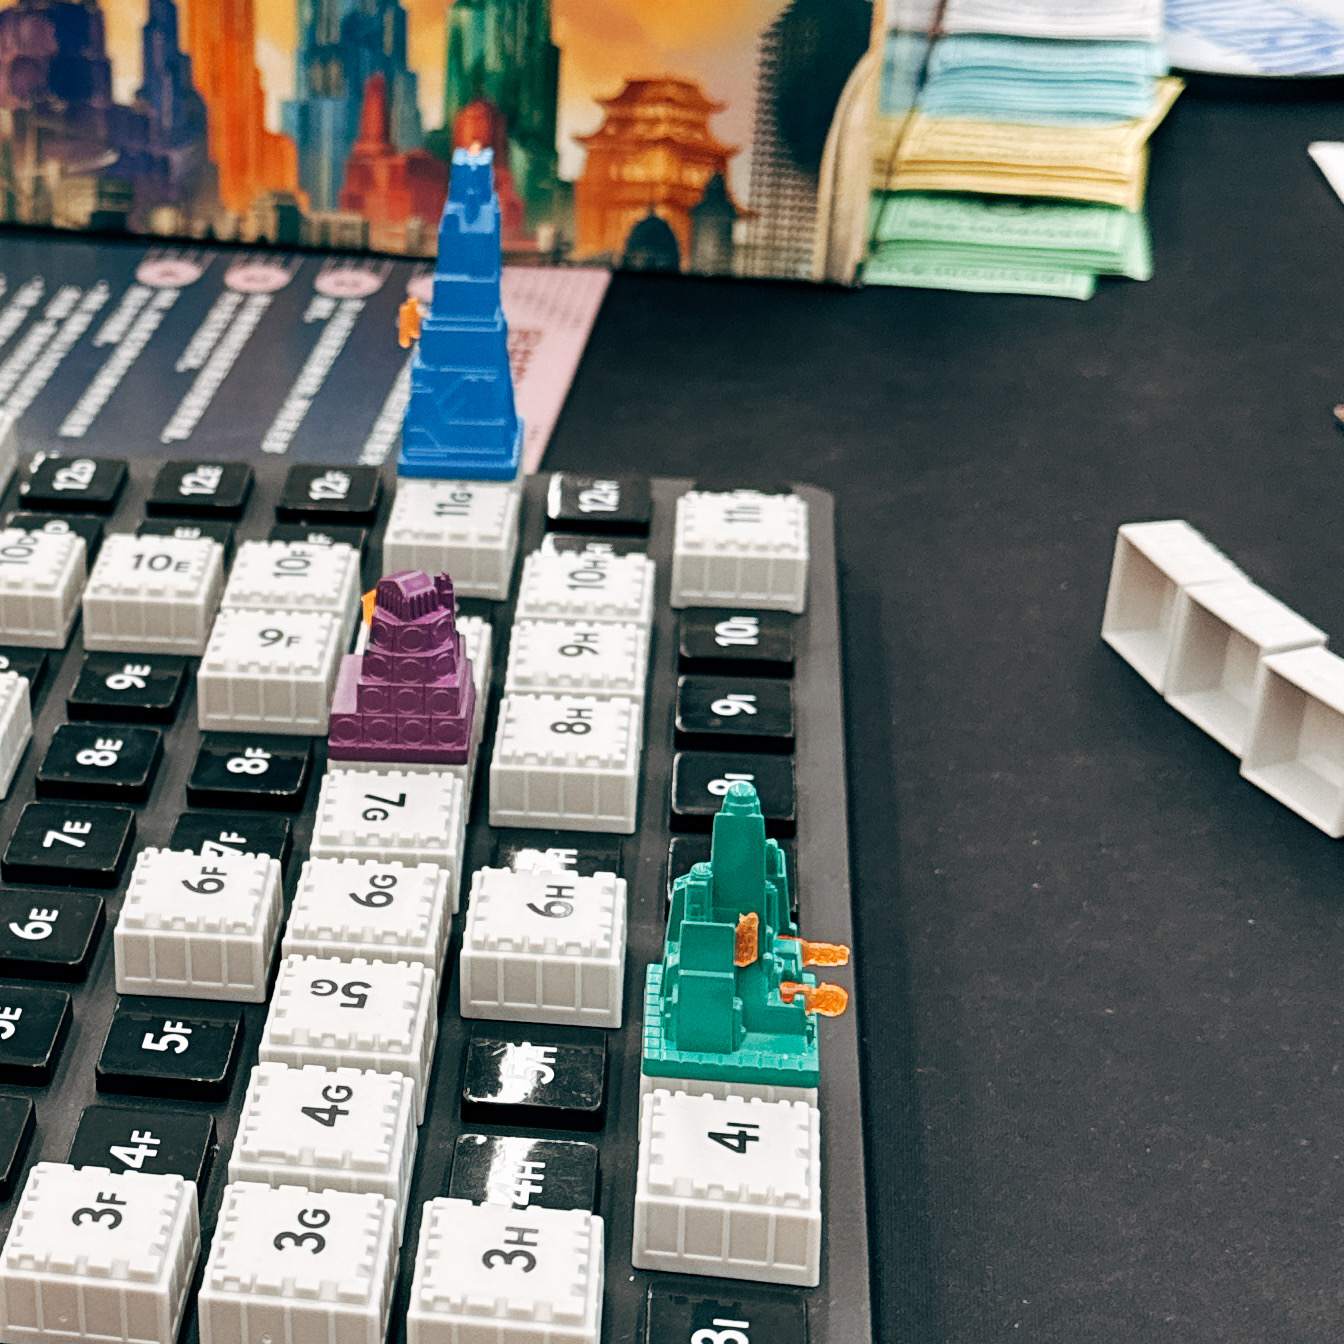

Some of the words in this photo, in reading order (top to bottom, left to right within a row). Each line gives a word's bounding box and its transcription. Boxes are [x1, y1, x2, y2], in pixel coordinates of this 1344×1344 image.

[52, 459, 96, 490] 12D
[180, 465, 223, 496] 12E
[309, 470, 351, 500] 12F
[434, 491, 472, 517] 11G
[579, 480, 620, 512] 12H
[132, 553, 191, 573] 10E
[273, 550, 312, 576] 10F
[568, 557, 606, 591] 10H
[259, 628, 301, 648] 9F
[558, 632, 599, 657] 9H
[715, 617, 759, 646] 10I
[106, 664, 152, 690] 9E
[711, 694, 757, 716] 9I
[550, 708, 592, 734] 8H
[76, 738, 124, 767] 8E
[226, 747, 272, 775] 8F
[361, 792, 407, 822] 7G
[42, 820, 93, 848] 7E
[201, 831, 247, 857] 7F
[181, 866, 227, 895] 6F
[349, 874, 397, 908] 6G
[527, 884, 575, 918] 6H
[10, 906, 58, 941] 6E
[310, 979, 373, 1009] 5G
[141, 1020, 193, 1054] 5F
[301, 1085, 354, 1127] 4G
[109, 1129, 161, 1169] 4F
[708, 1121, 760, 1154] 4I
[504, 1161, 546, 1206] 4H
[71, 1191, 127, 1230] 3F
[273, 1208, 331, 1255] 3G
[481, 1226, 539, 1273] 3H
